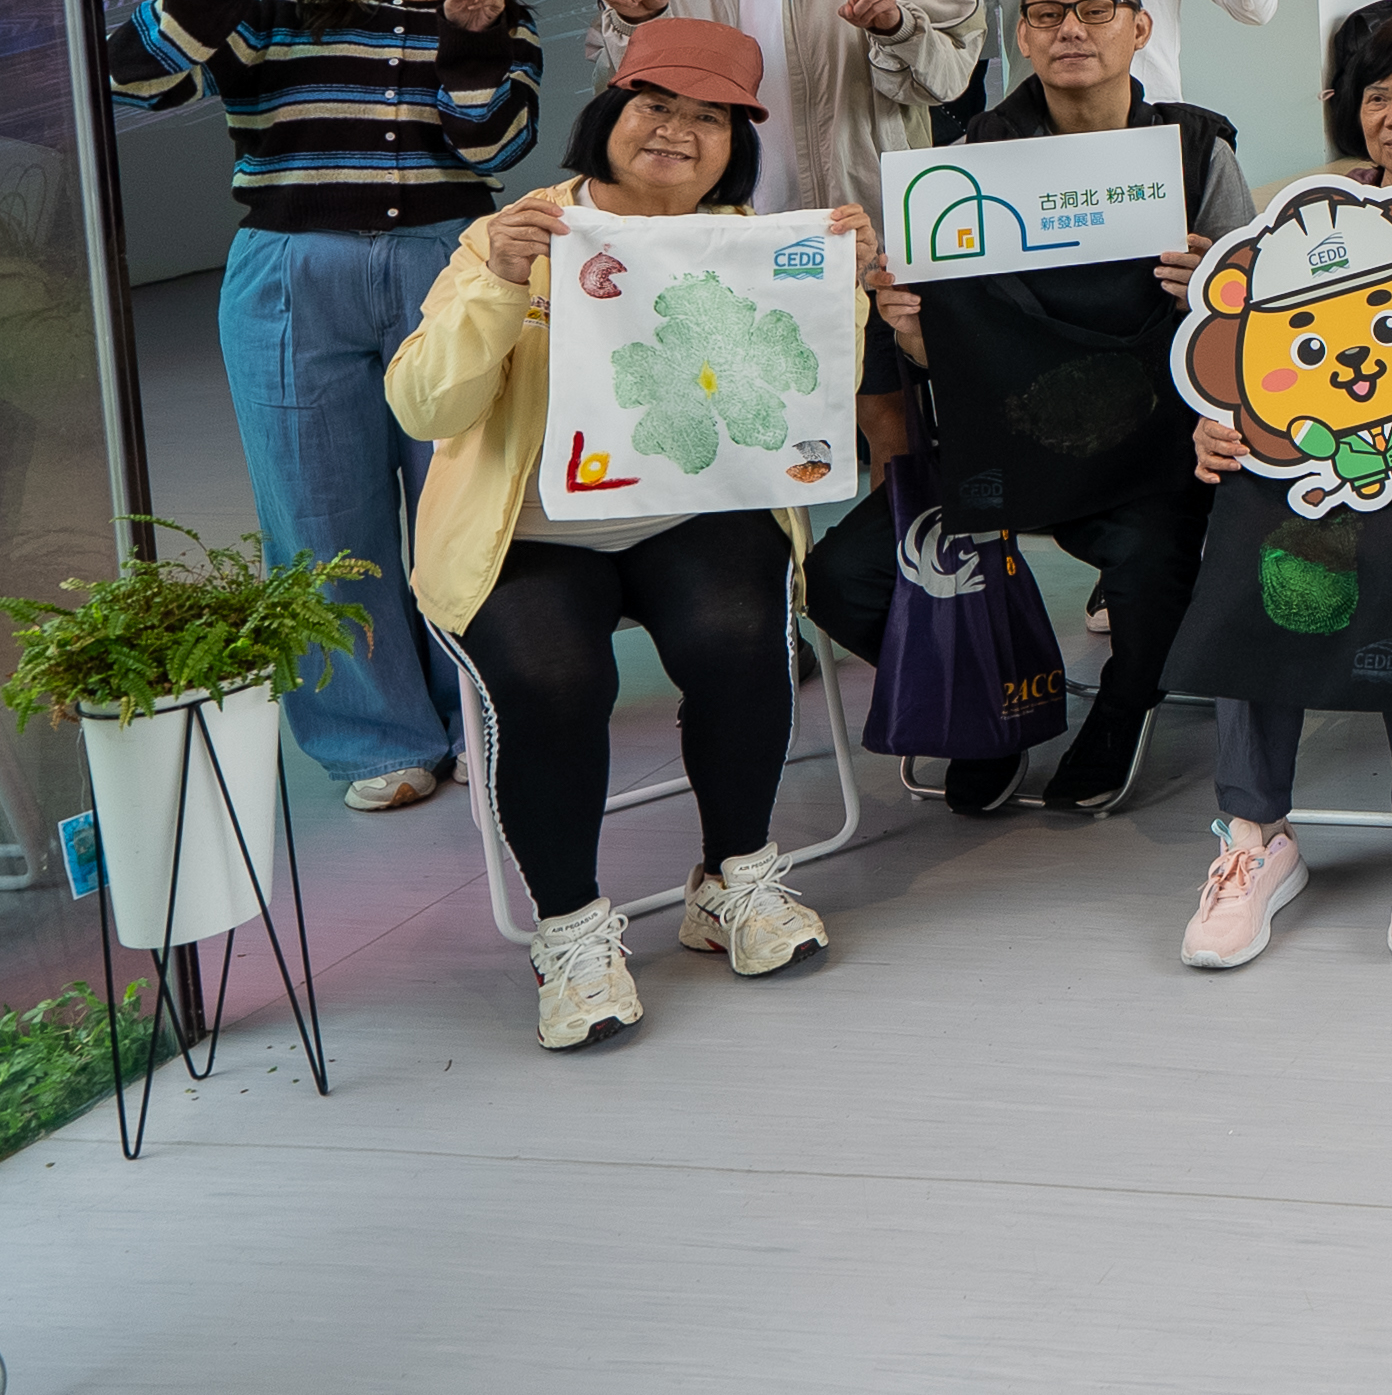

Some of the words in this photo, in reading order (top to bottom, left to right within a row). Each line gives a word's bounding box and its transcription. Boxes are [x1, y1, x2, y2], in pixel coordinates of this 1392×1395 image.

[1038, 188, 1100, 211] 古洞北
[1106, 182, 1167, 204] 粉嶺北
[1040, 211, 1106, 232] 新發展區
[773, 251, 825, 267] CEDD
[1308, 246, 1347, 266] CEDD
[565, 912, 599, 931] PEGASUS
